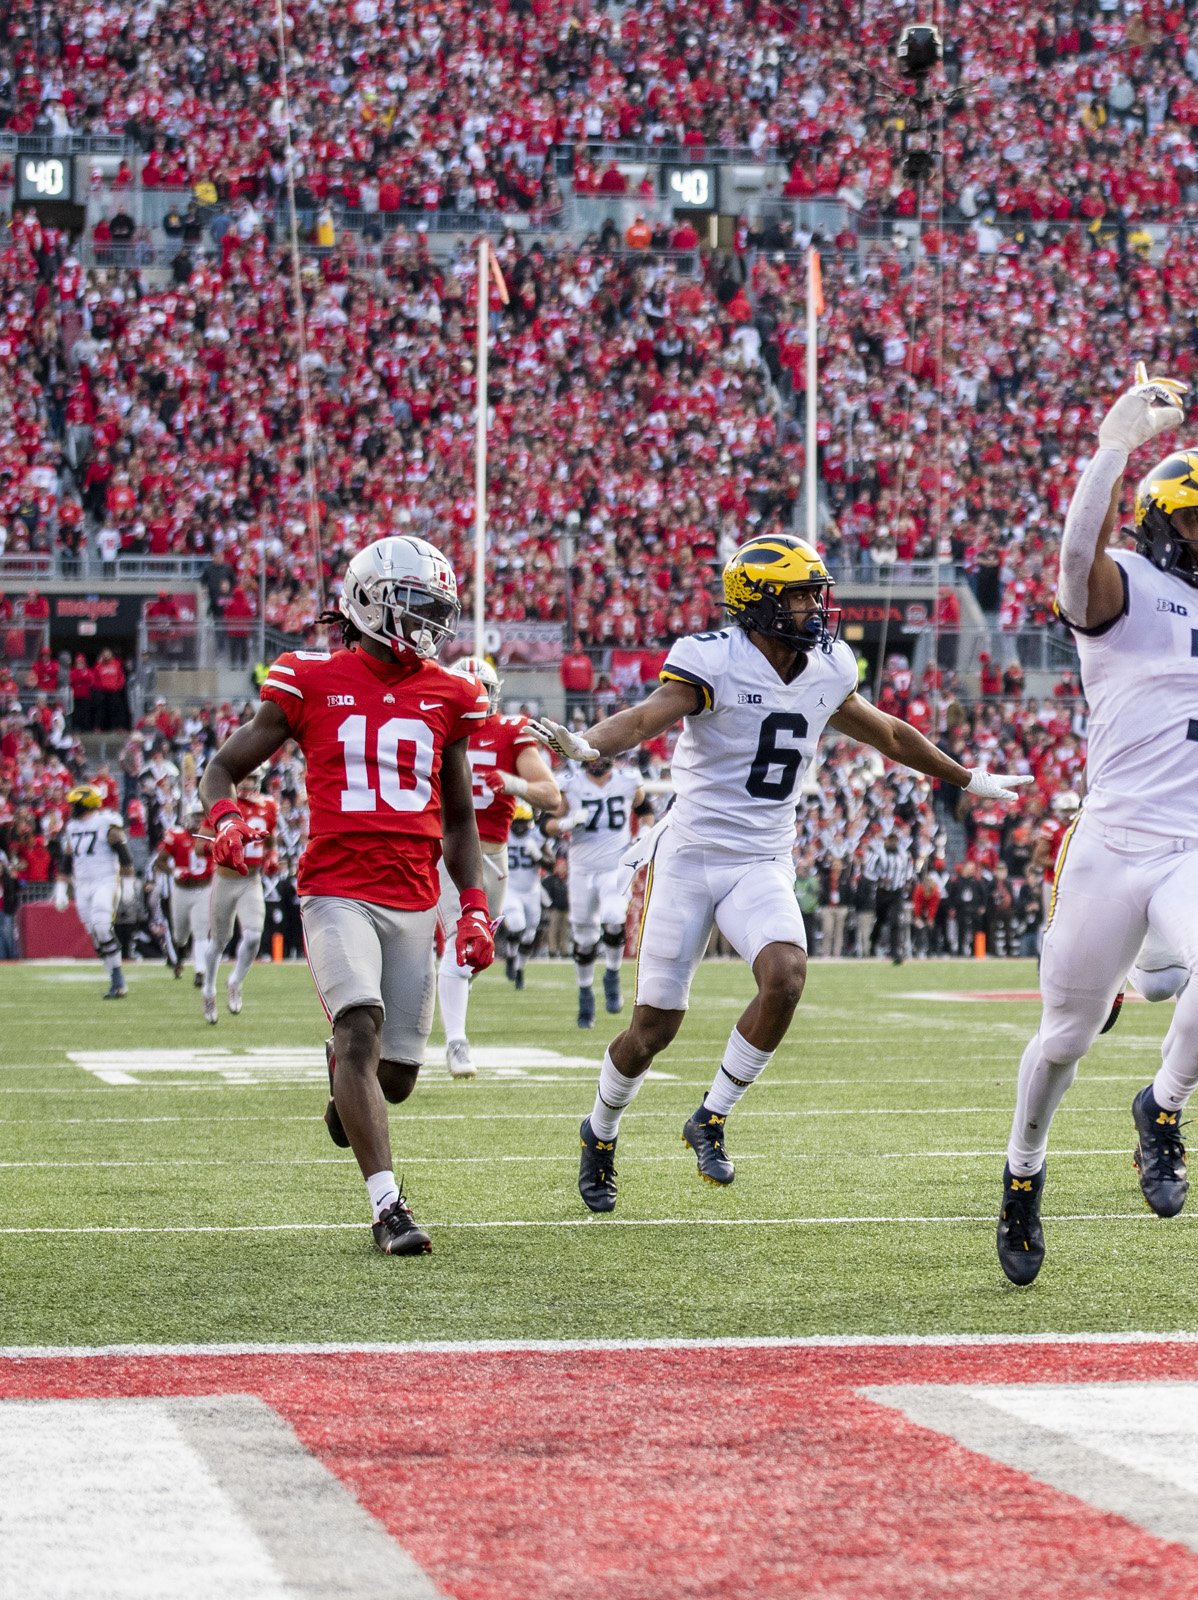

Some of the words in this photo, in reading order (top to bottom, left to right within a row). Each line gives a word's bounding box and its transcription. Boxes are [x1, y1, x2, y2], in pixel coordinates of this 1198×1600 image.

[25, 159, 64, 195] 40
[671, 169, 709, 204] 40
[337, 714, 435, 812] 10
[745, 712, 809, 801] 6
[582, 796, 627, 833] 76
[71, 830, 98, 856] 77
[508, 846, 534, 869] 55
[1156, 1111, 1178, 1125] M
[1010, 1178, 1033, 1192] M
